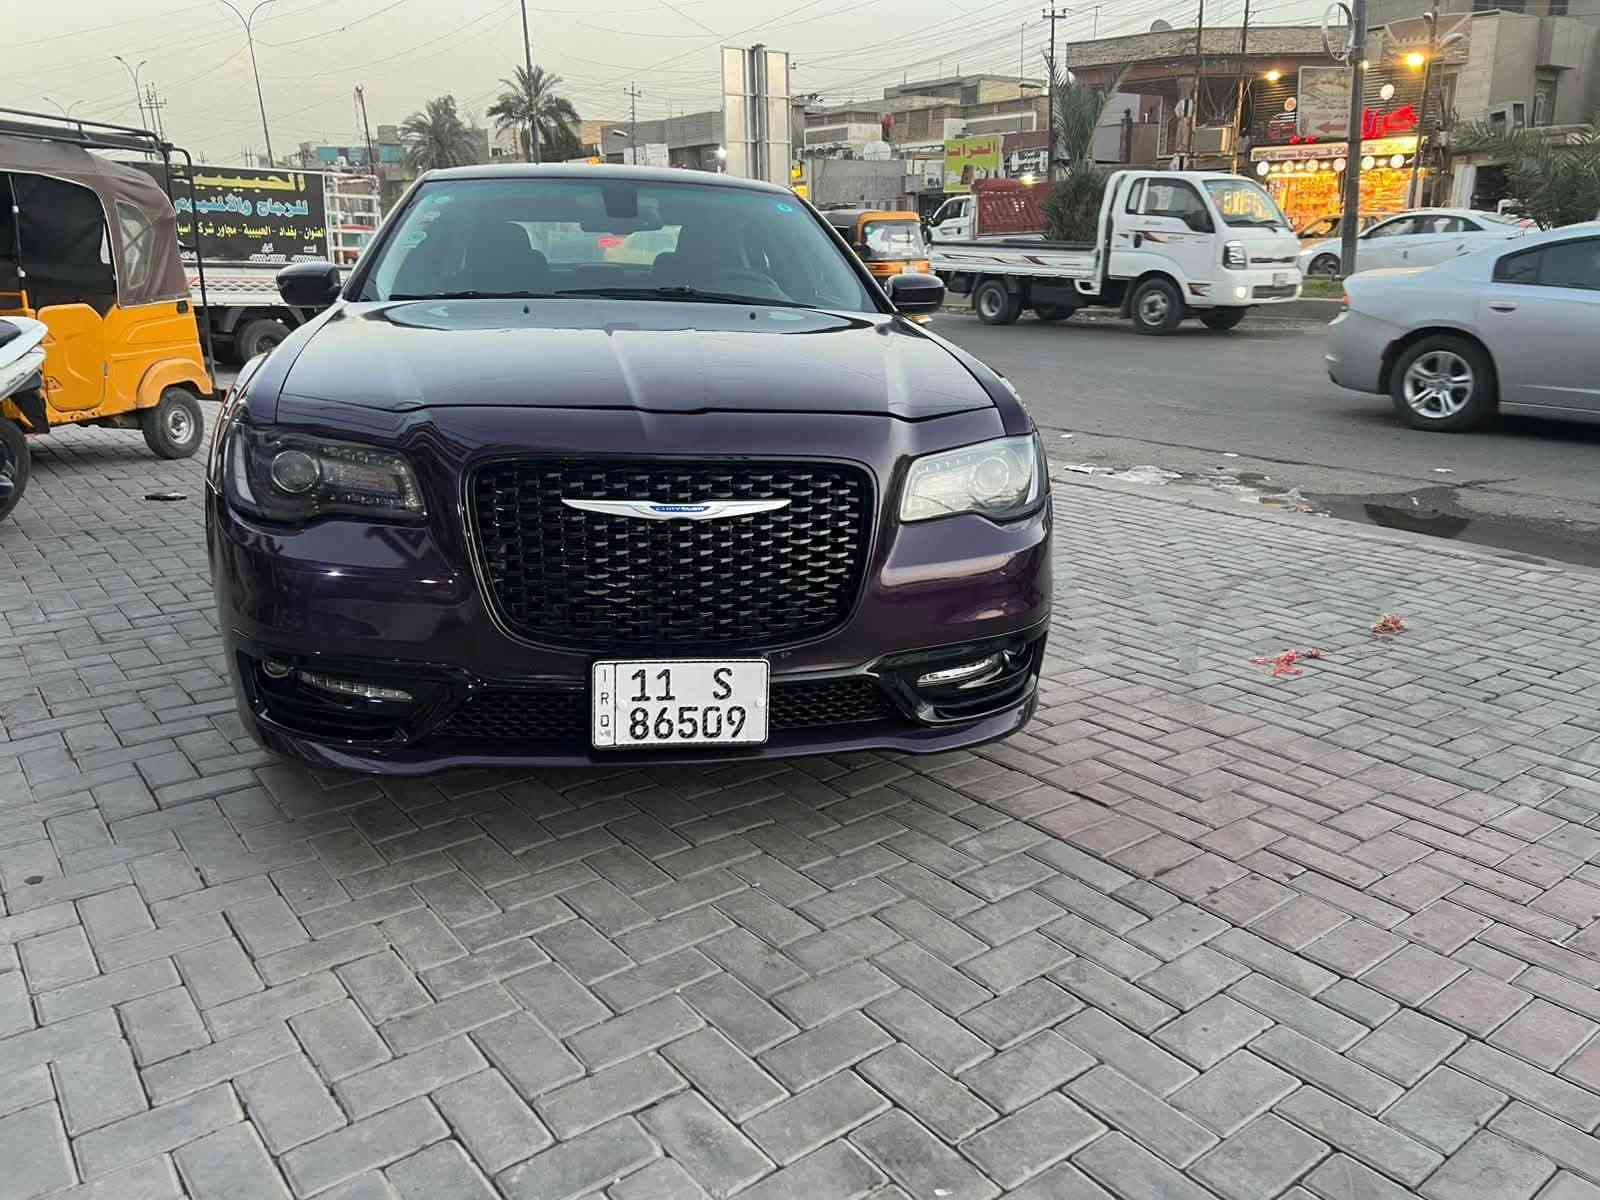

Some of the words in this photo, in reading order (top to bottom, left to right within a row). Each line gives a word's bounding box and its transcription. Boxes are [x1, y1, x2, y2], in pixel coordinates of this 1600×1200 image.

[279, 224, 297, 240] بغداد
[631, 668, 676, 702] 11
[712, 667, 733, 701] S
[629, 705, 746, 741] 86509
